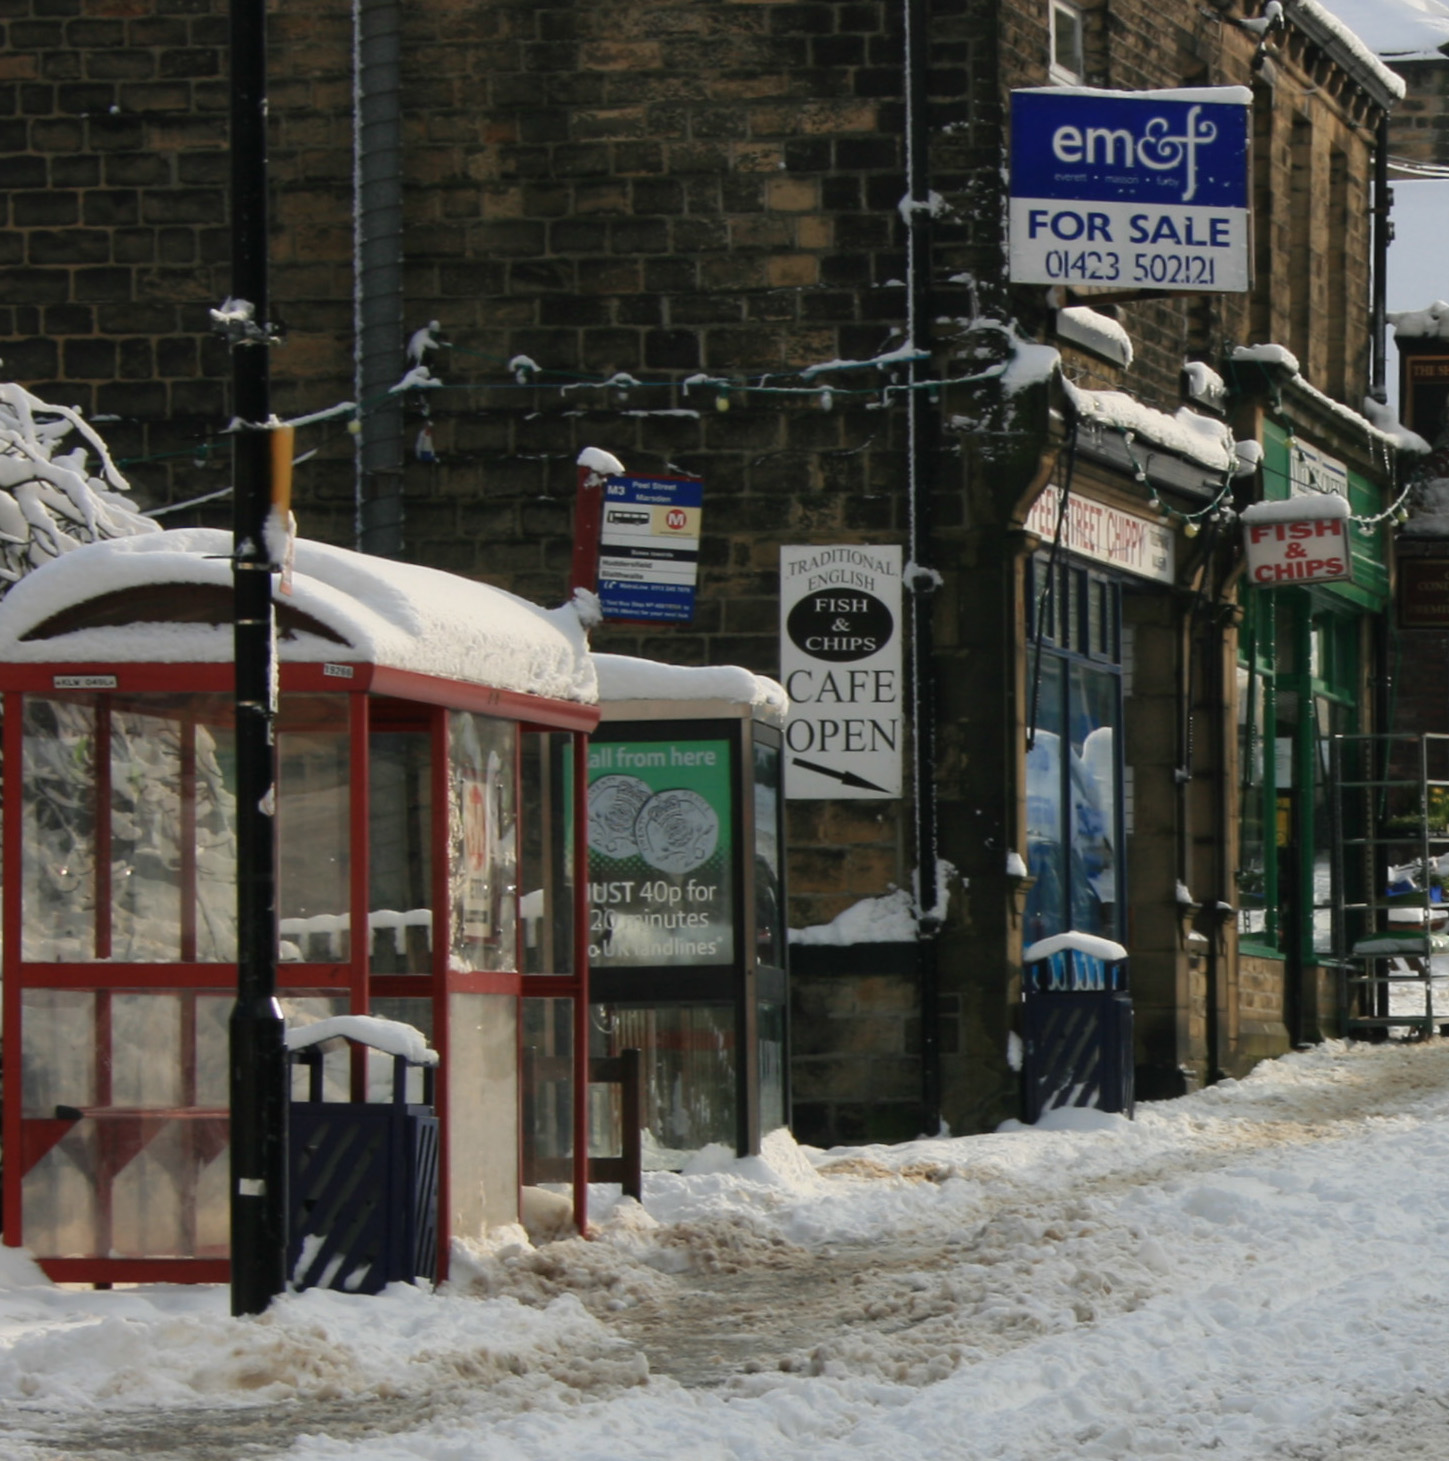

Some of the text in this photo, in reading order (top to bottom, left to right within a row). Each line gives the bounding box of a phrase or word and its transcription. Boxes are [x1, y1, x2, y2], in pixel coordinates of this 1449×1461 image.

[1052, 105, 1218, 202] em&f
[1054, 172, 1088, 183] everett
[1028, 209, 1231, 248] FOR SALE
[1045, 249, 1215, 285] 01423 502121
[1413, 364, 1434, 377] THE
[607, 484, 626, 496] M3
[632, 480, 677, 491] Peel Street
[635, 494, 672, 503] Marsden
[1250, 518, 1342, 545] FISH
[788, 548, 893, 577] TRADITIONAL
[1284, 541, 1308, 561] &
[807, 569, 876, 592] ENGLISH
[1254, 556, 1345, 584] CHIPS
[814, 598, 869, 613] FISH
[831, 617, 851, 633] &
[805, 636, 877, 651] CHIPS
[786, 669, 897, 704] CAFE
[785, 718, 899, 753] OPEN
[587, 745, 716, 769] all from here
[639, 880, 682, 907] 40p
[687, 878, 718, 902] for
[589, 907, 710, 931] 20 minutes
[587, 944, 600, 958] o
